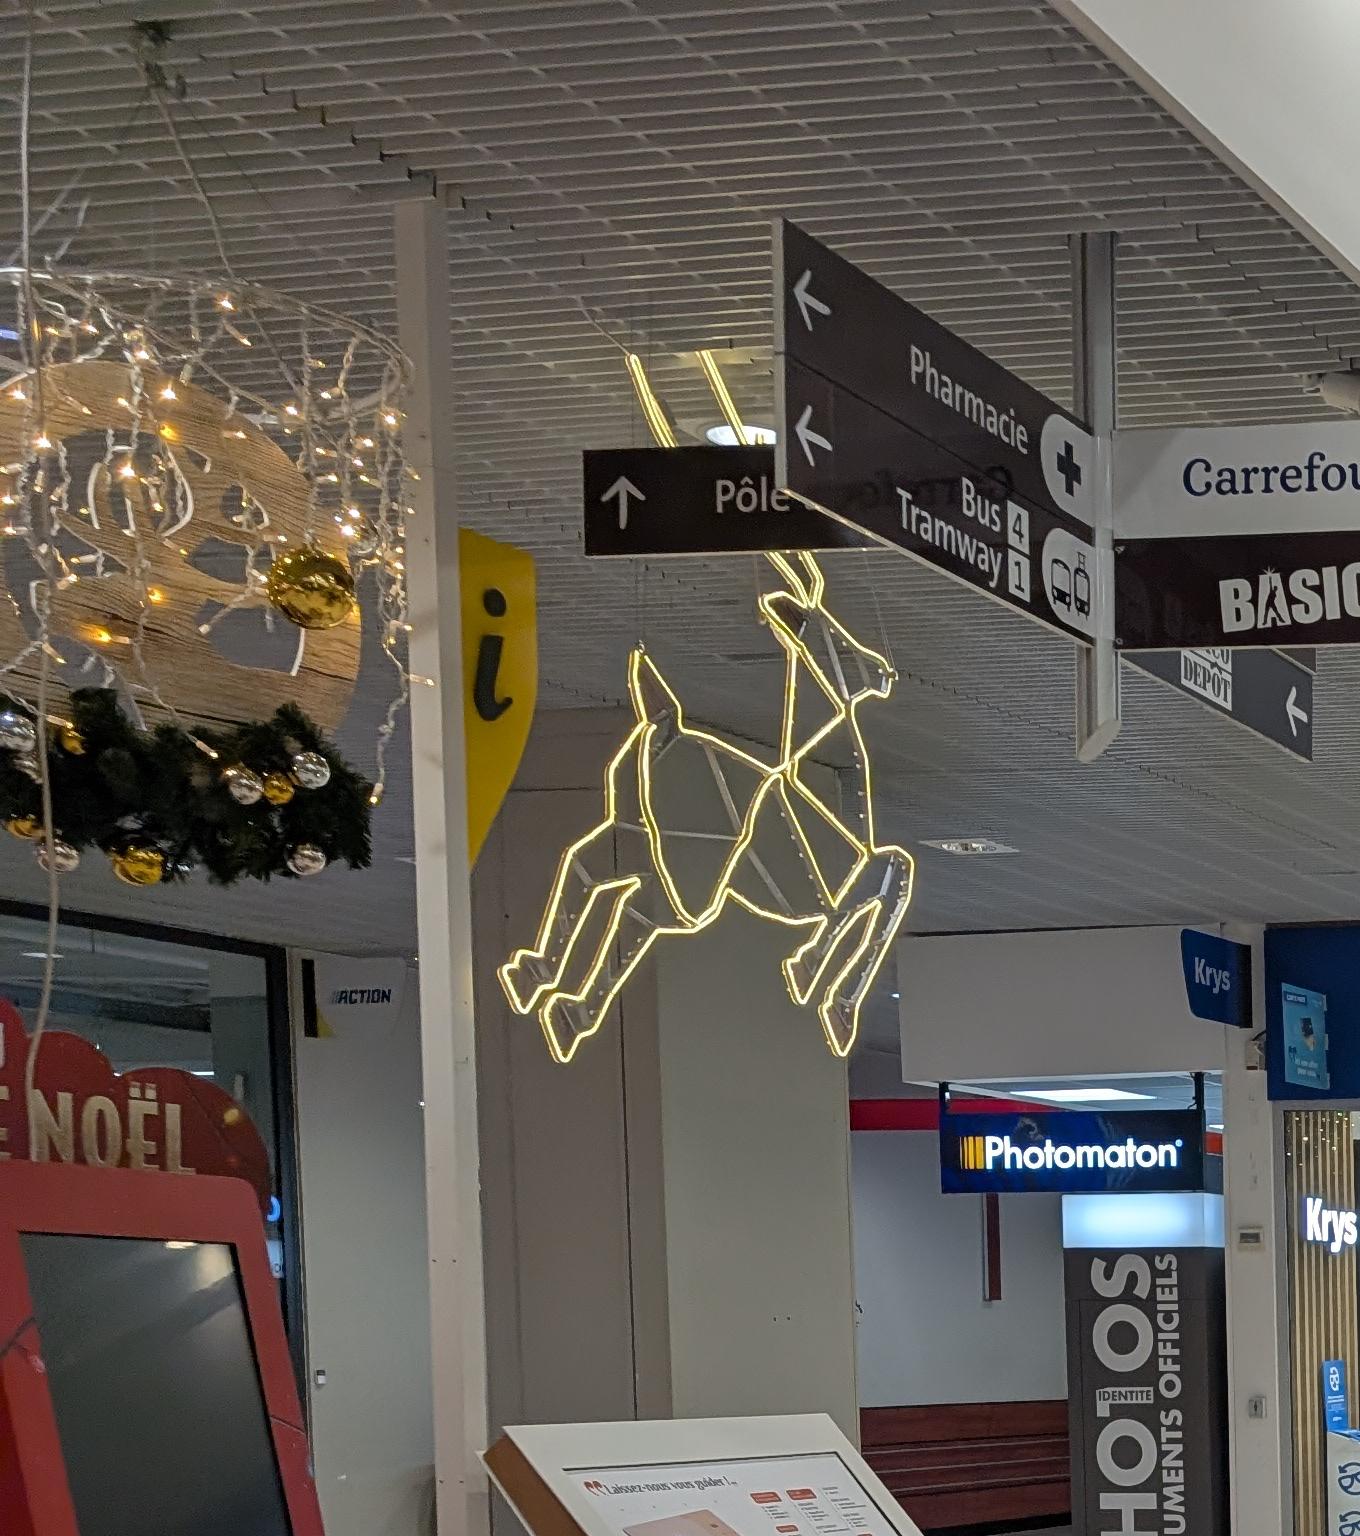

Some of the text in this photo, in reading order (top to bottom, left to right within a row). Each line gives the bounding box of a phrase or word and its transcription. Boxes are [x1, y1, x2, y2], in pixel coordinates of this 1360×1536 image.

[909, 344, 1030, 454] Pharmacie
[716, 476, 790, 513] Pôle
[961, 477, 1001, 532] Bus
[896, 486, 1002, 588] Tramway
[1012, 512, 1025, 543] 4
[1014, 561, 1025, 594] 1
[1194, 957, 1231, 994] Krys
[336, 988, 392, 1005] ACTION
[29, 1082, 196, 1175] NOËL
[984, 1135, 1178, 1170] Photomaton
[1306, 1198, 1358, 1253] Krys
[1155, 1253, 1183, 1399] OFFICIELS
[1098, 1389, 1153, 1403] IDENTITE
[604, 1481, 671, 1496] Laissez-nous
[671, 1479, 697, 1490] vous
[694, 1476, 725, 1491] guider
